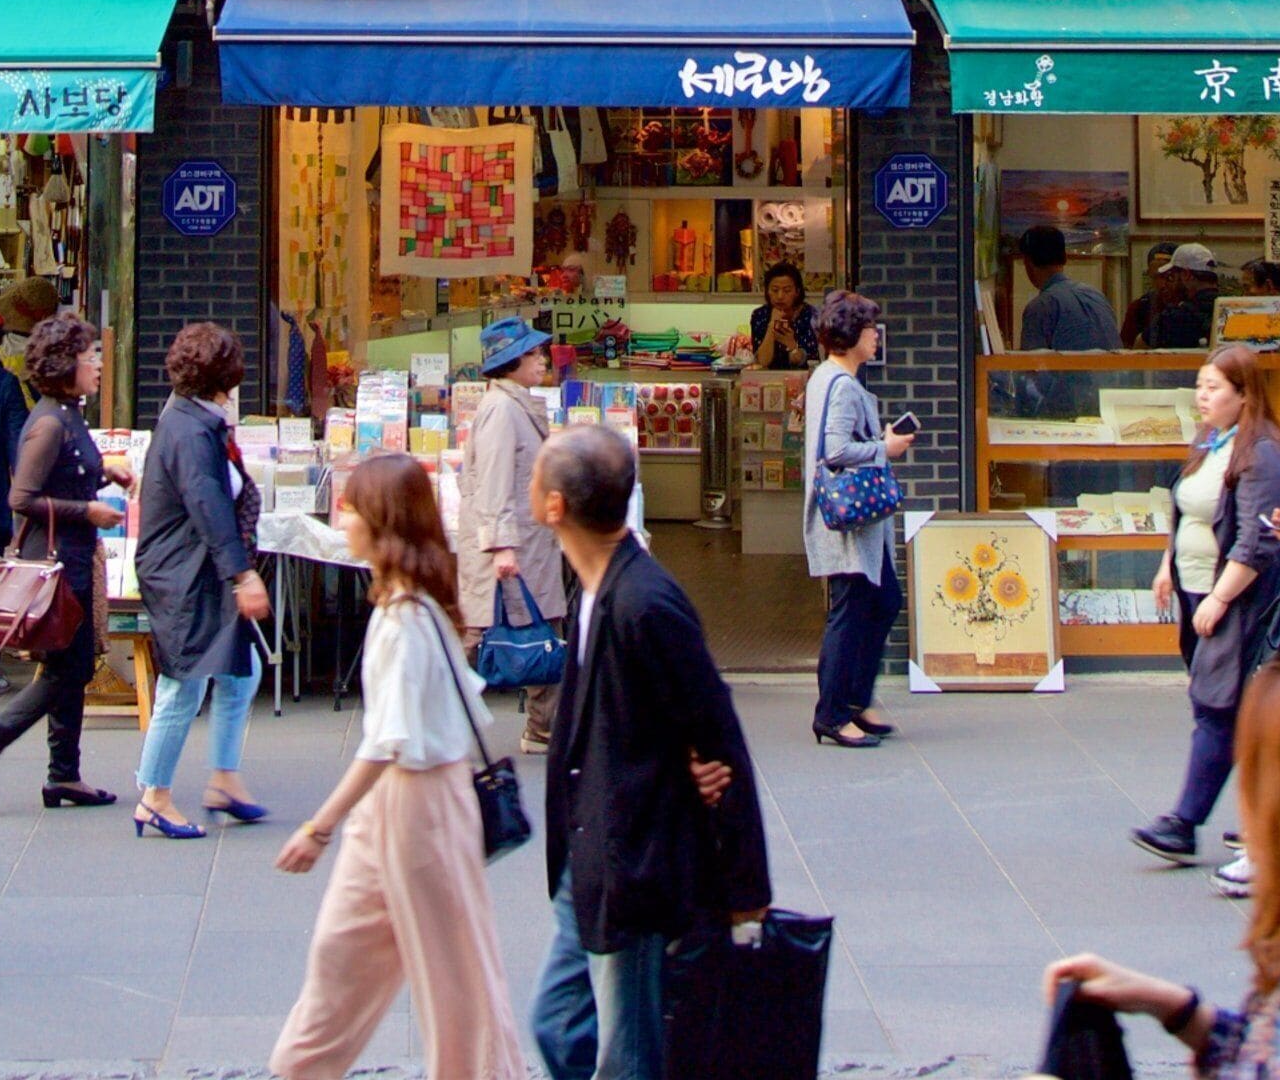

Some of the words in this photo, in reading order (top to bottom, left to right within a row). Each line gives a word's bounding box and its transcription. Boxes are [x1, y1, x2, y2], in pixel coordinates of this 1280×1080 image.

[678, 51, 830, 103] 세로방
[19, 86, 128, 121] 사보당
[174, 184, 226, 211] ADT
[886, 177, 937, 204] ADT
[528, 294, 626, 309] Serobang
[556, 309, 622, 329] ロバン
